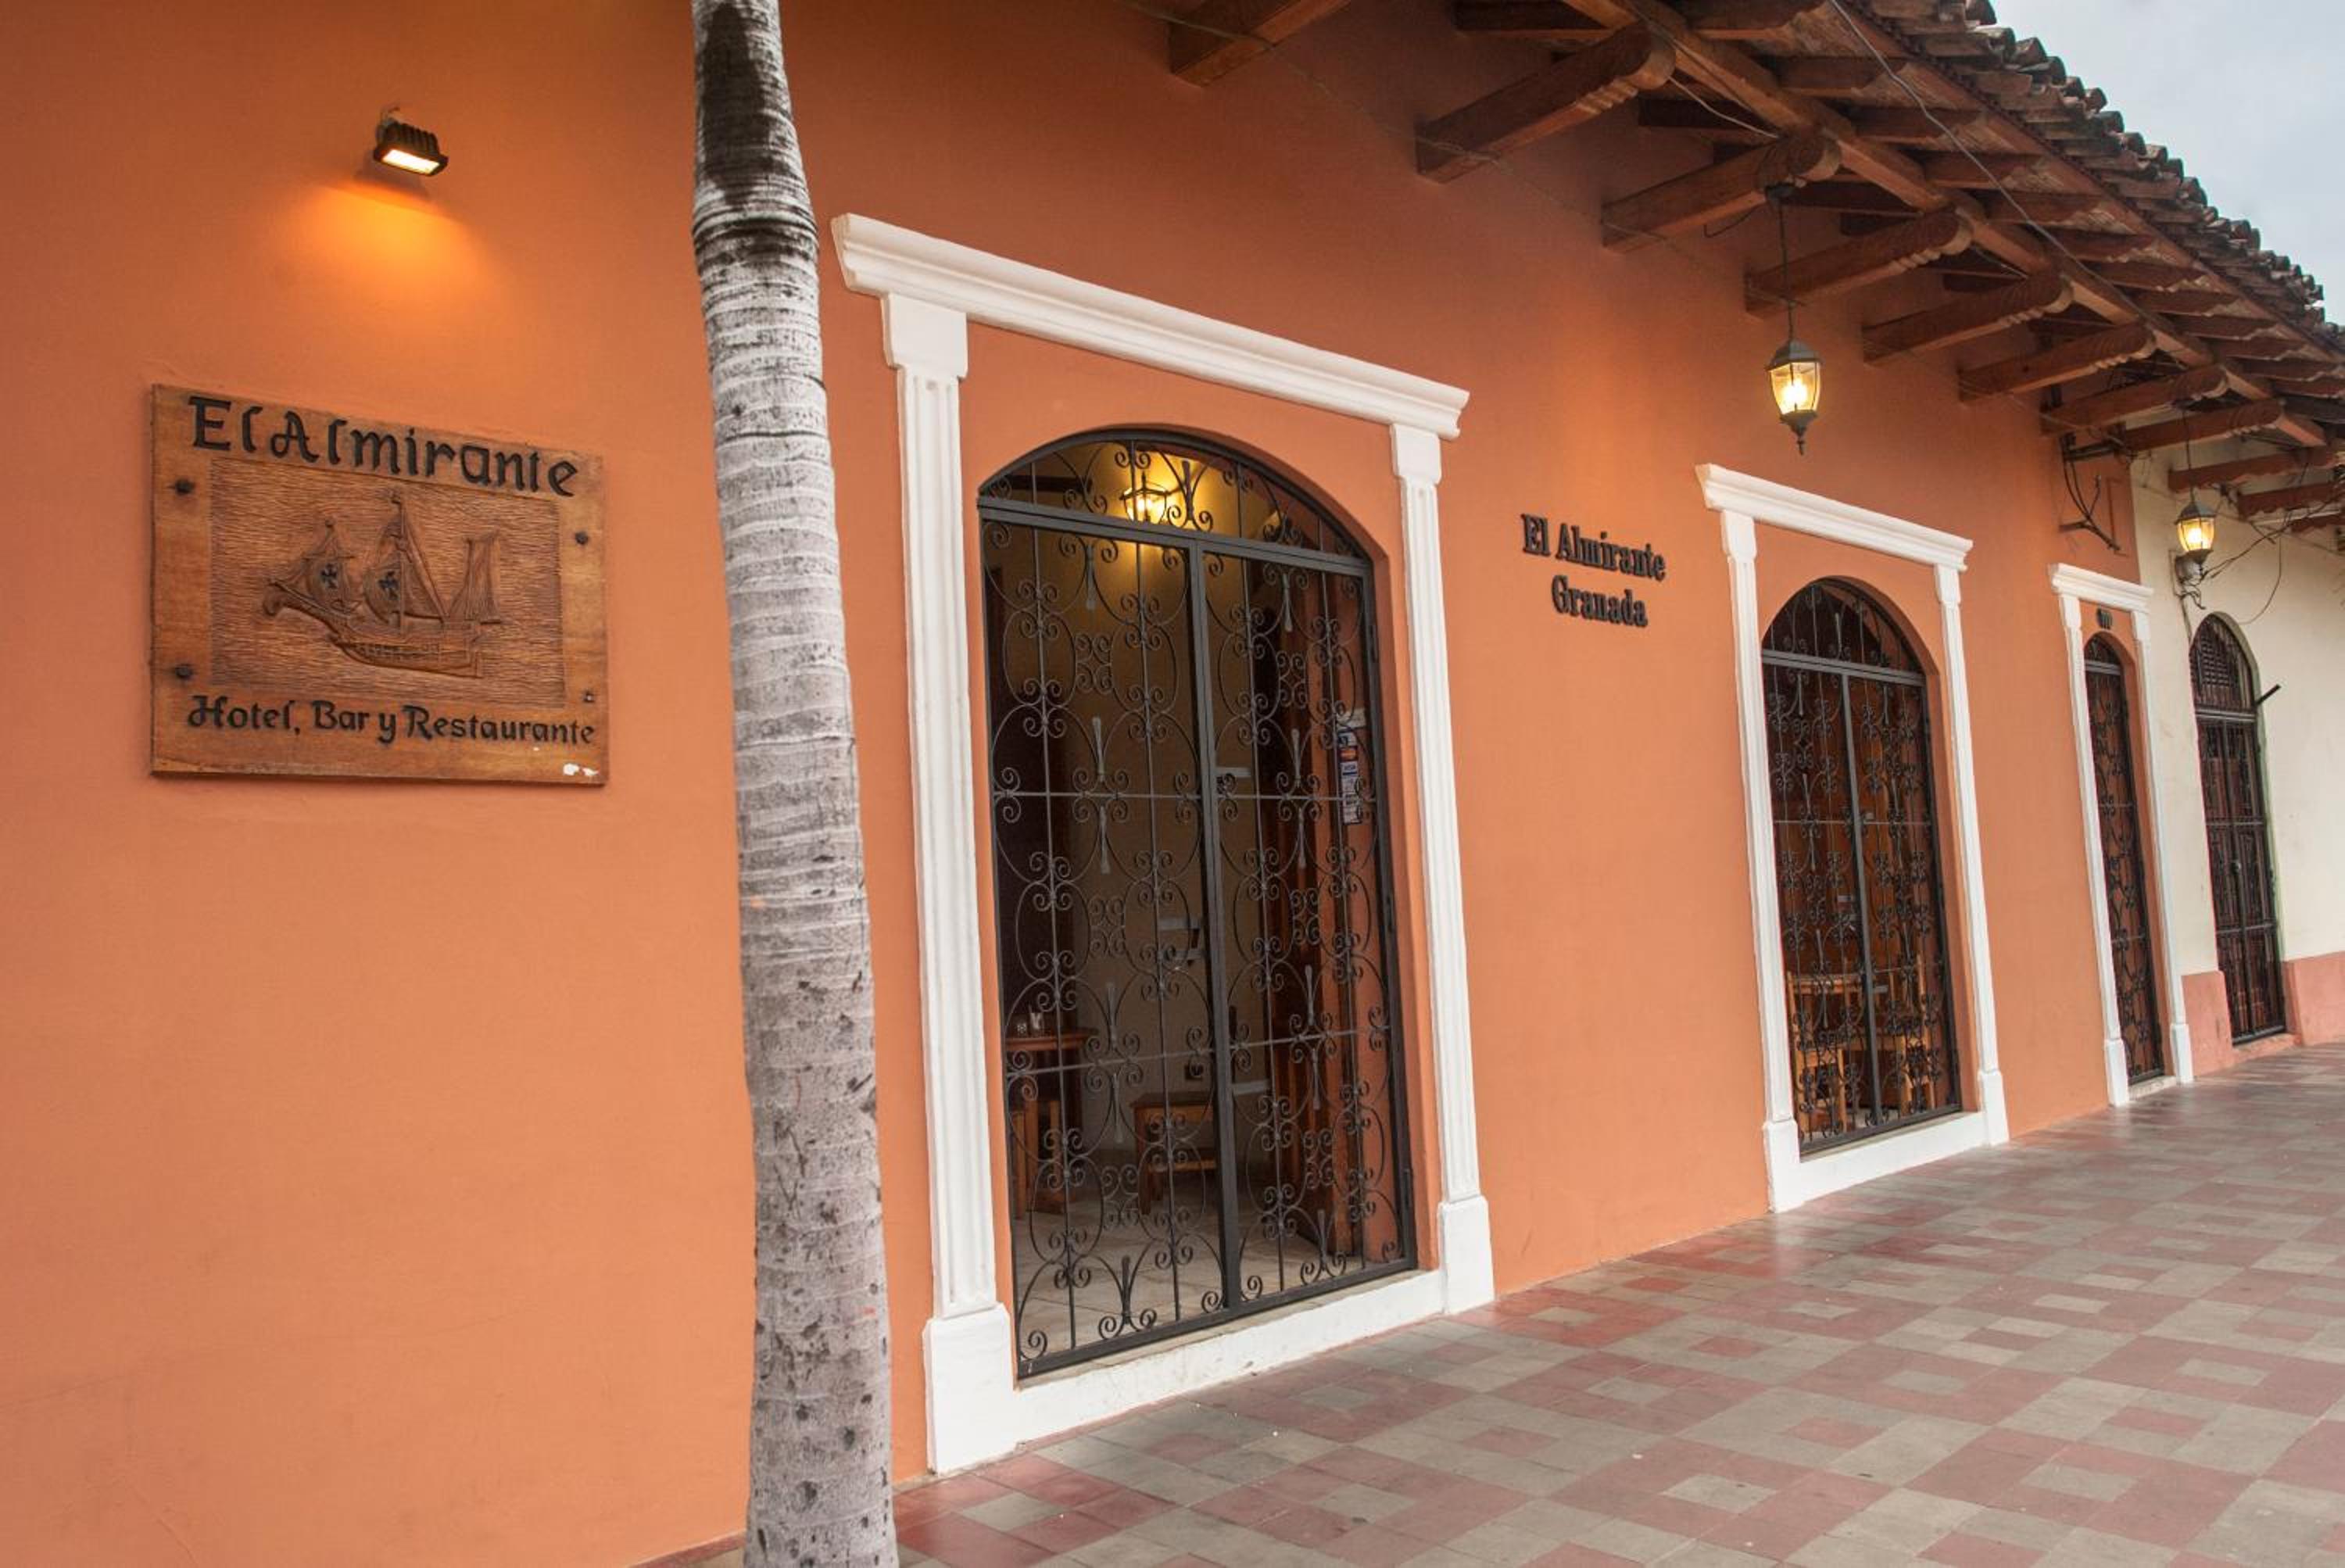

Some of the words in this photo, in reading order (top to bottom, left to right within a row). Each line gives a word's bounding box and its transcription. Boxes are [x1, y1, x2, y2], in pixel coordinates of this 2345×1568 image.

[270, 410, 578, 497] Almirante
[1520, 514, 1551, 557] El
[1555, 523, 1667, 582] Almirante
[1552, 574, 1649, 628] Granada
[311, 700, 371, 730] Bar
[378, 712, 397, 744] y
[403, 704, 595, 744] Restaurante
